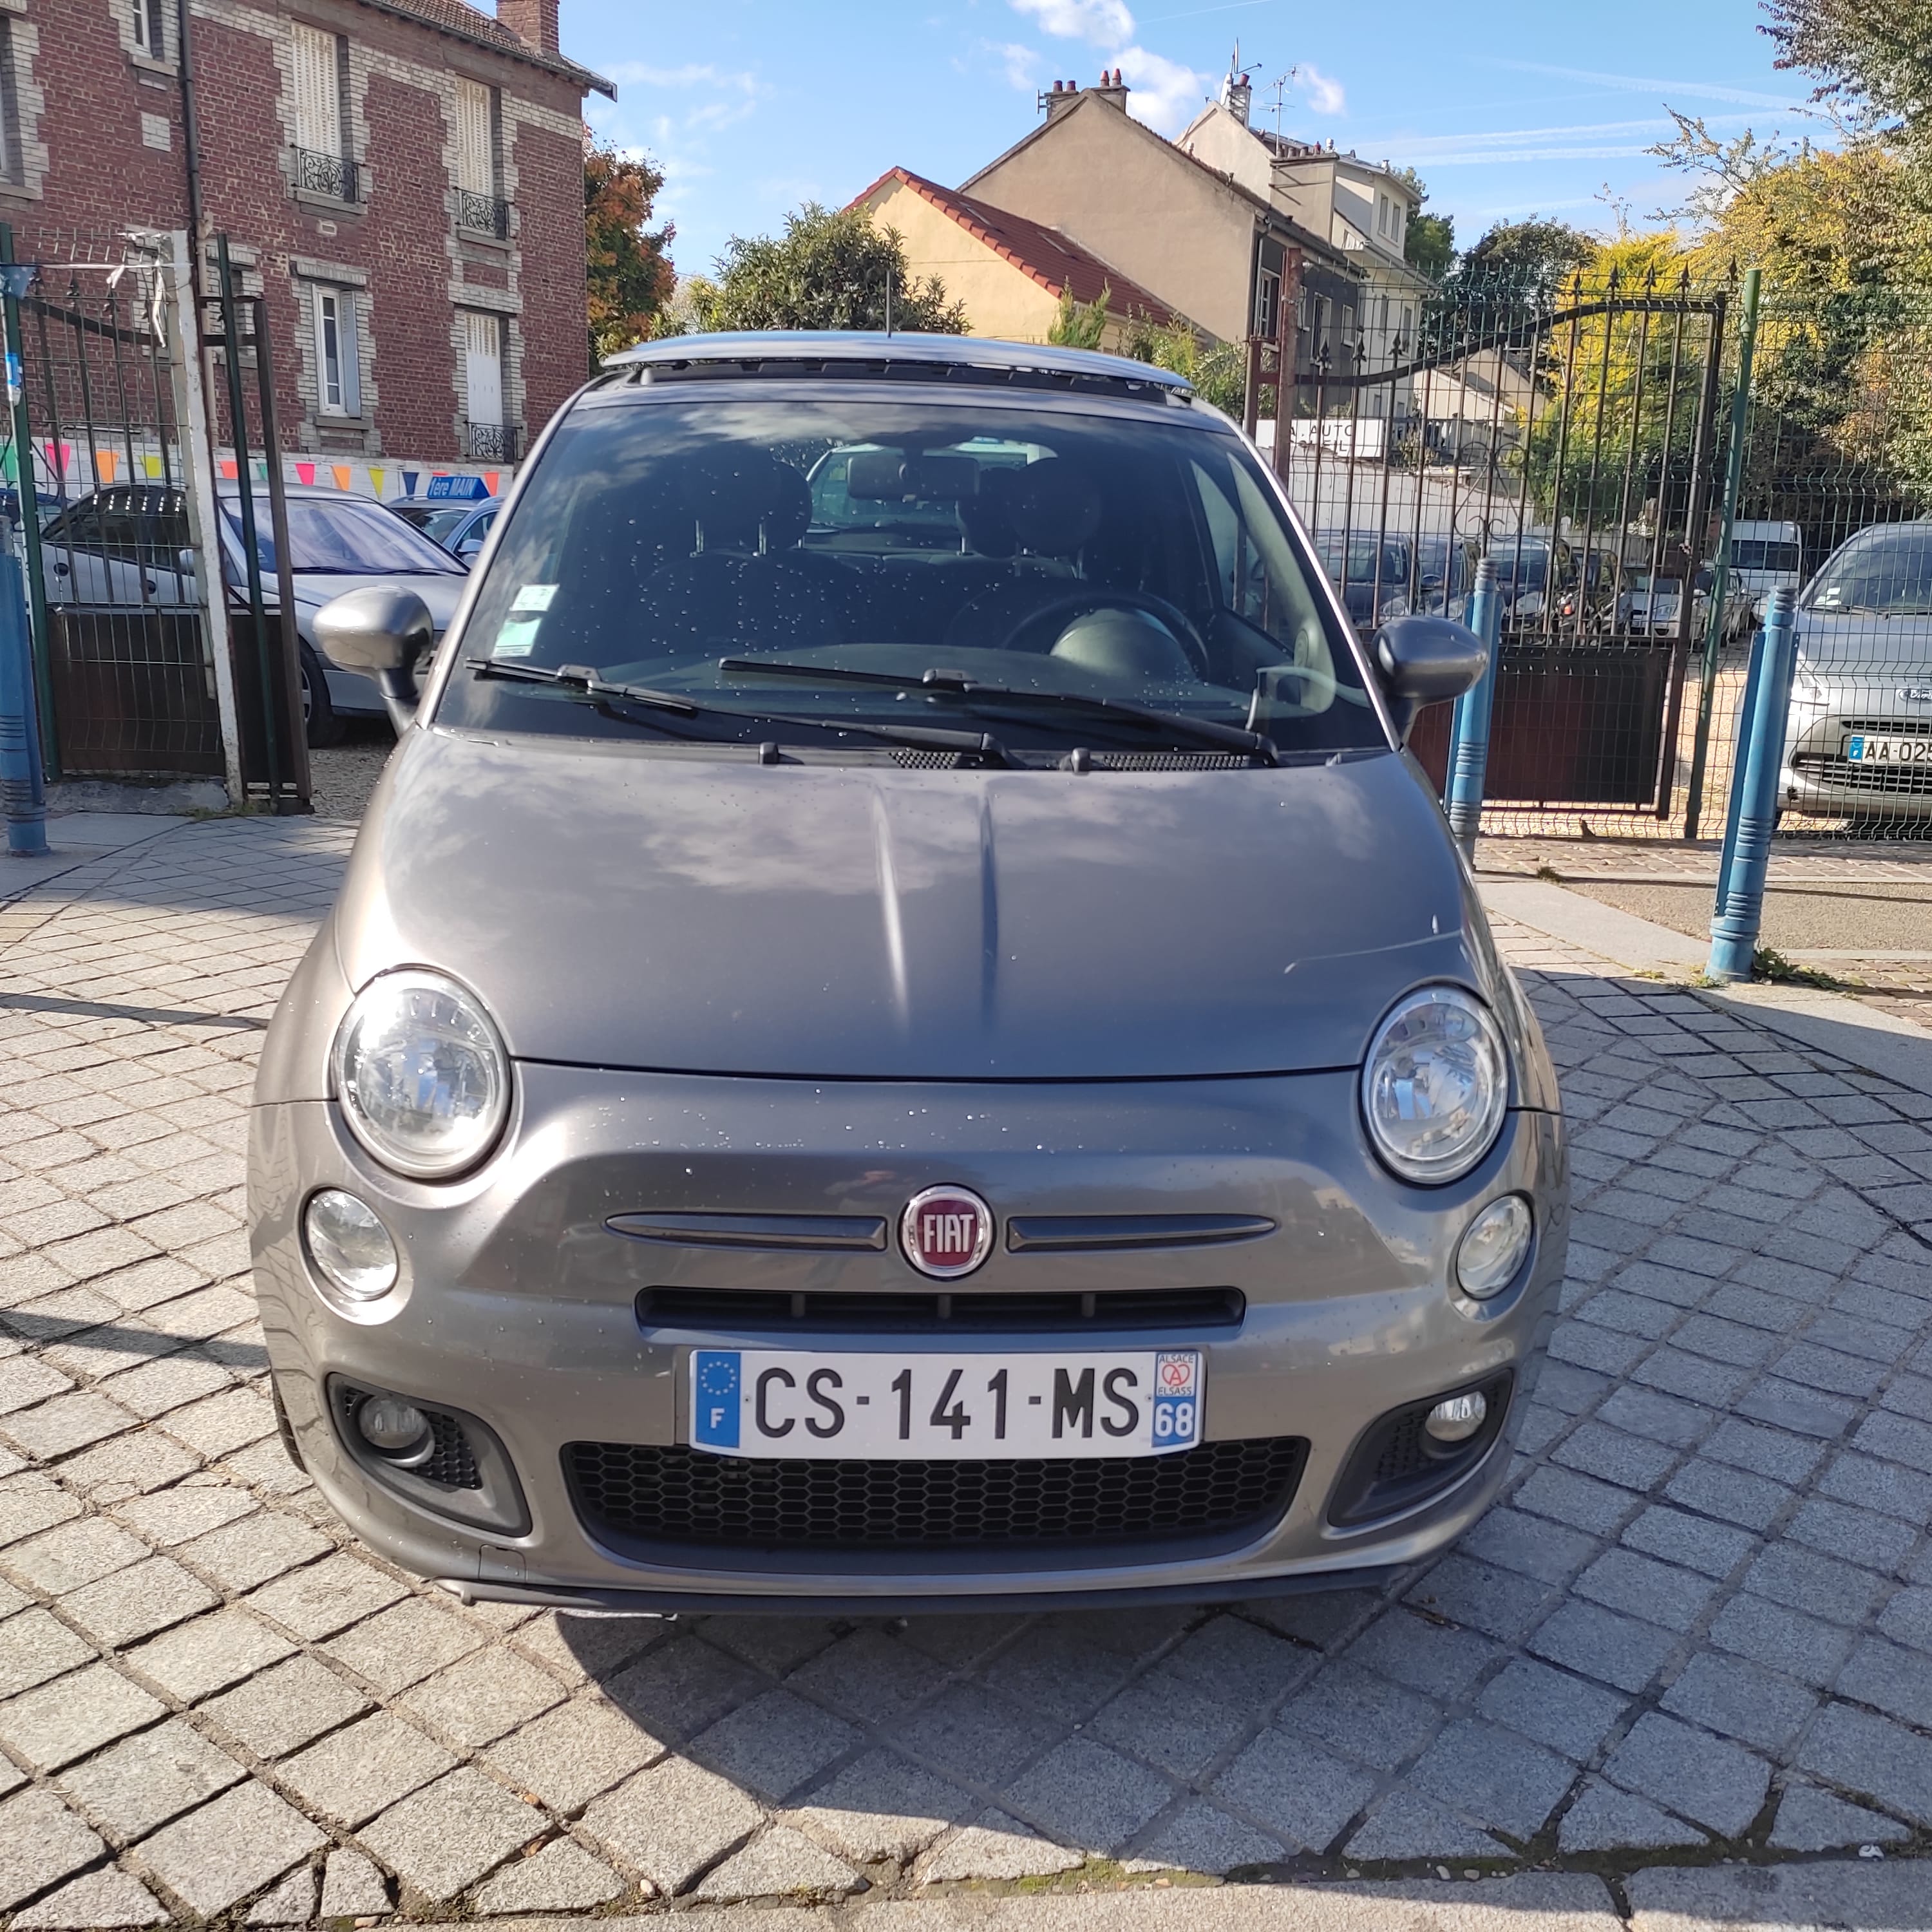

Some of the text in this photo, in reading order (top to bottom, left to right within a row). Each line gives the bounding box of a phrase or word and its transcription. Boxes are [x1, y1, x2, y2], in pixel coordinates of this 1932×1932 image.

[429, 477, 478, 496] 1ère MAIN
[923, 1214, 974, 1253] FIAT
[1159, 1354, 1194, 1363] ALSACE
[1158, 1387, 1192, 1396] ELSASS
[755, 1367, 1140, 1440] CS-141-MS
[710, 1407, 725, 1429] F
[1155, 1402, 1193, 1437] 68
